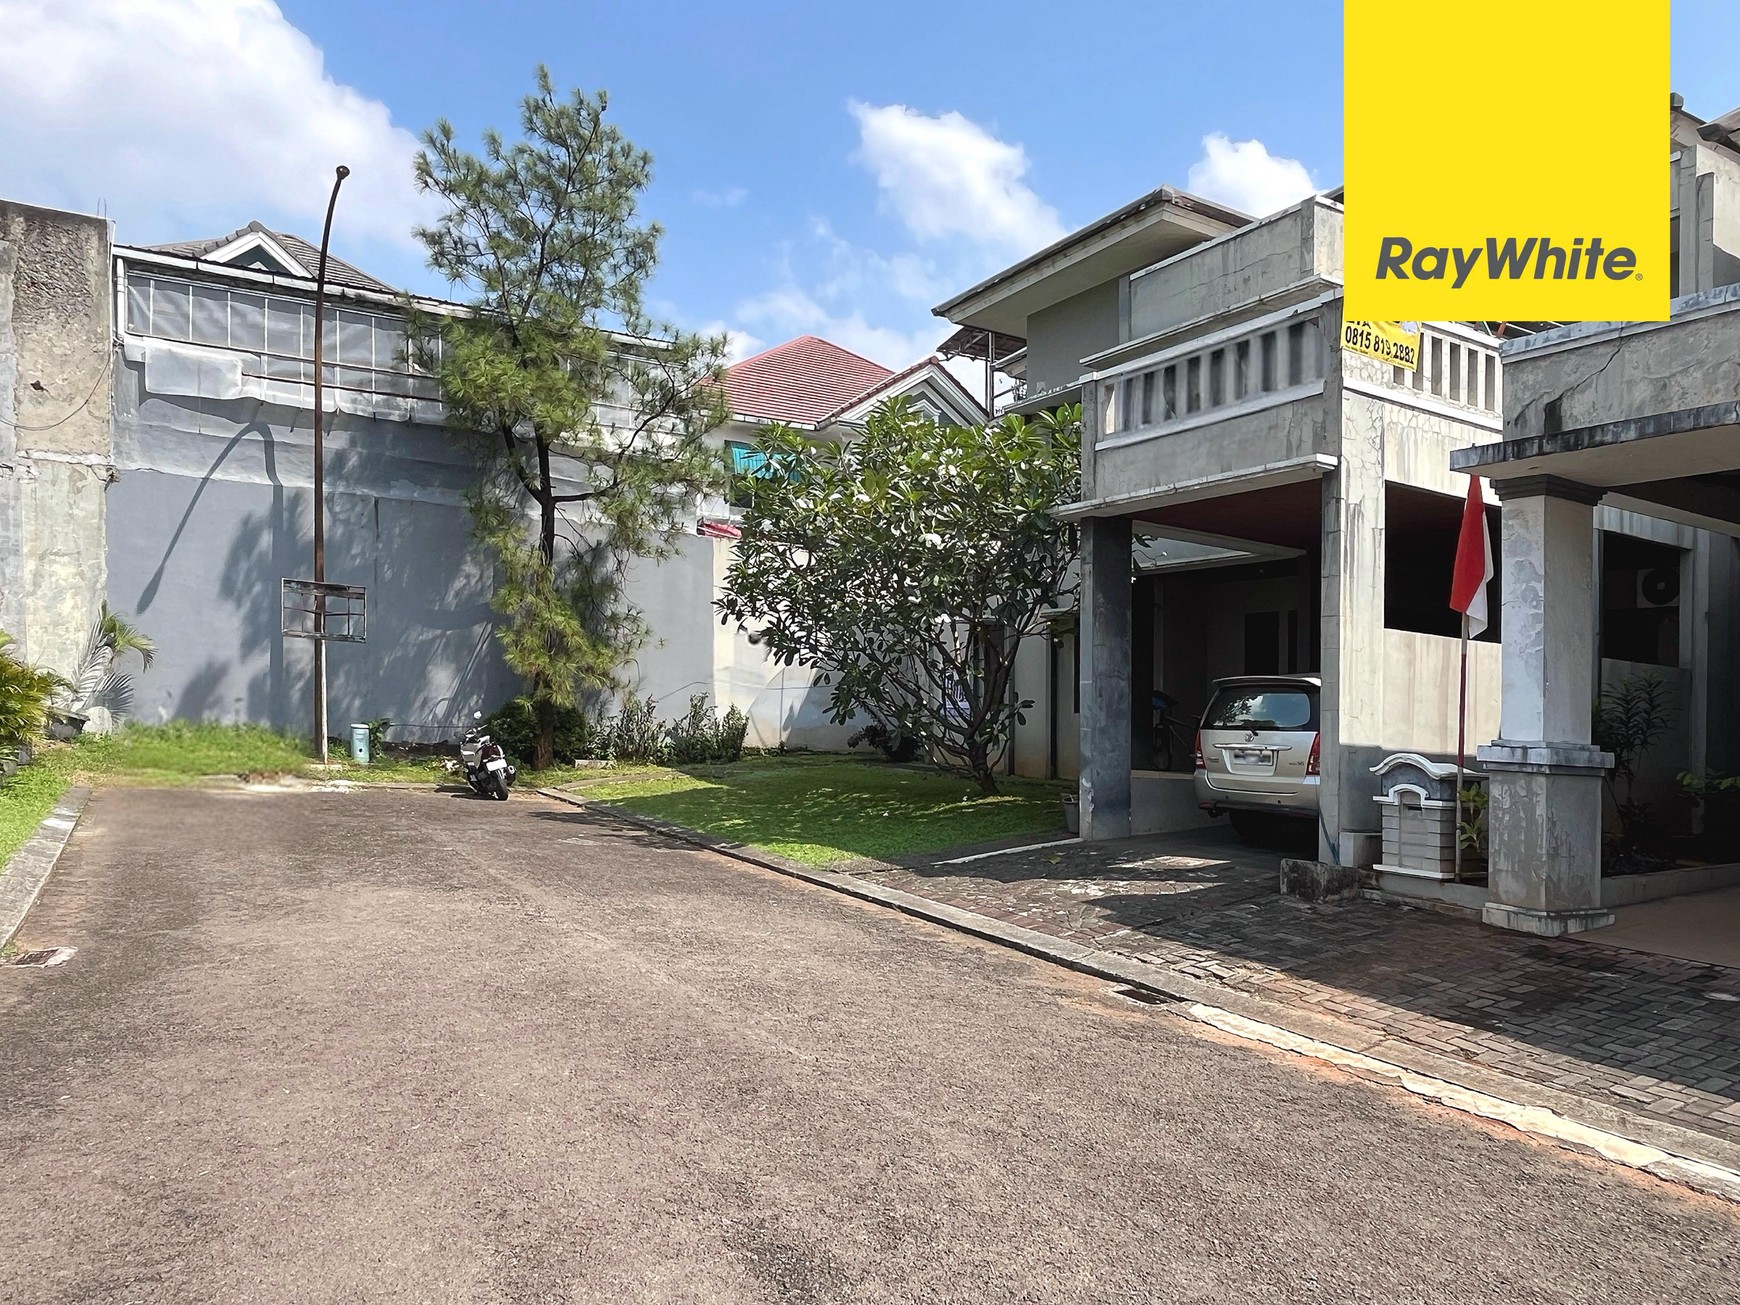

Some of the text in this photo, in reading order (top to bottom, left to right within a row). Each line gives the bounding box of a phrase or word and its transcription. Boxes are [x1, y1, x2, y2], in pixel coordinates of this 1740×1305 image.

[1345, 326, 1371, 349] 0815
[1373, 335, 1391, 356] 819
[1393, 342, 1415, 364] 2882
